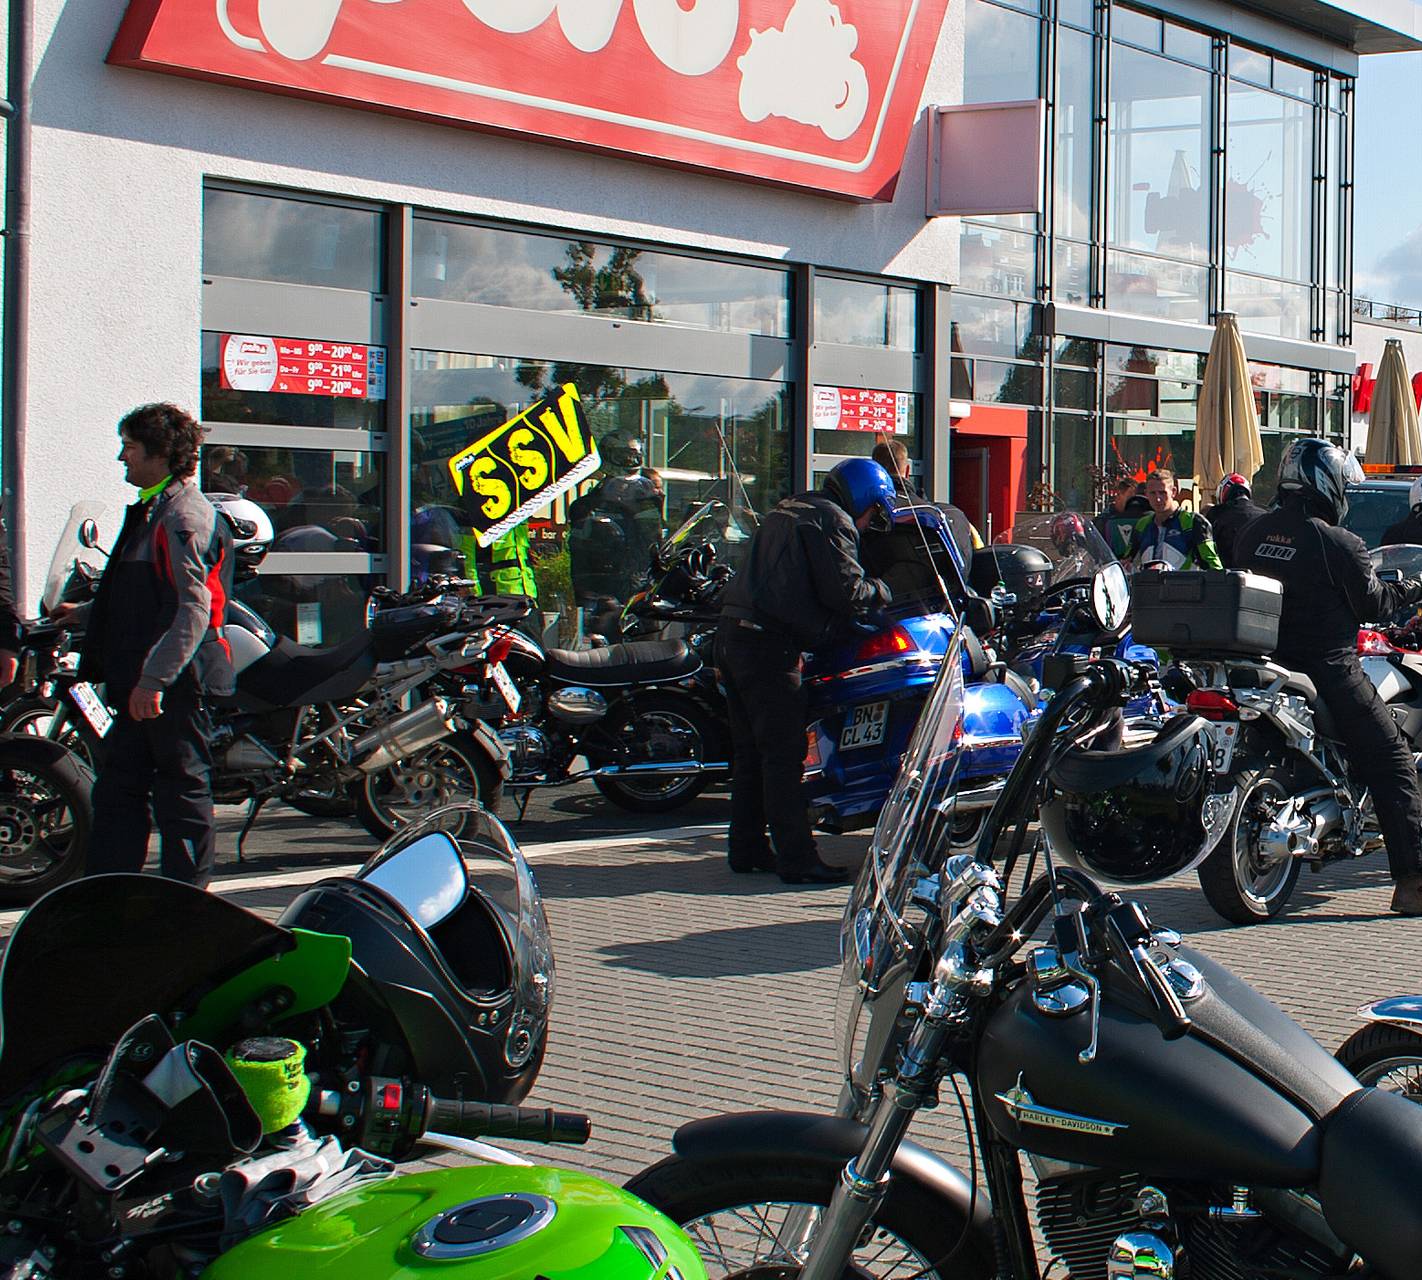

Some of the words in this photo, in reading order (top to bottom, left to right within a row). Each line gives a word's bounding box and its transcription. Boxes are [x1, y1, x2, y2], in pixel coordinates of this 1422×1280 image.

[469, 392, 586, 520] SSV
[854, 706, 873, 726] BN
[842, 728, 861, 746] CL
[863, 723, 883, 742] 43
[1023, 1111, 1103, 1133] HARLEY-DAVIDSON
